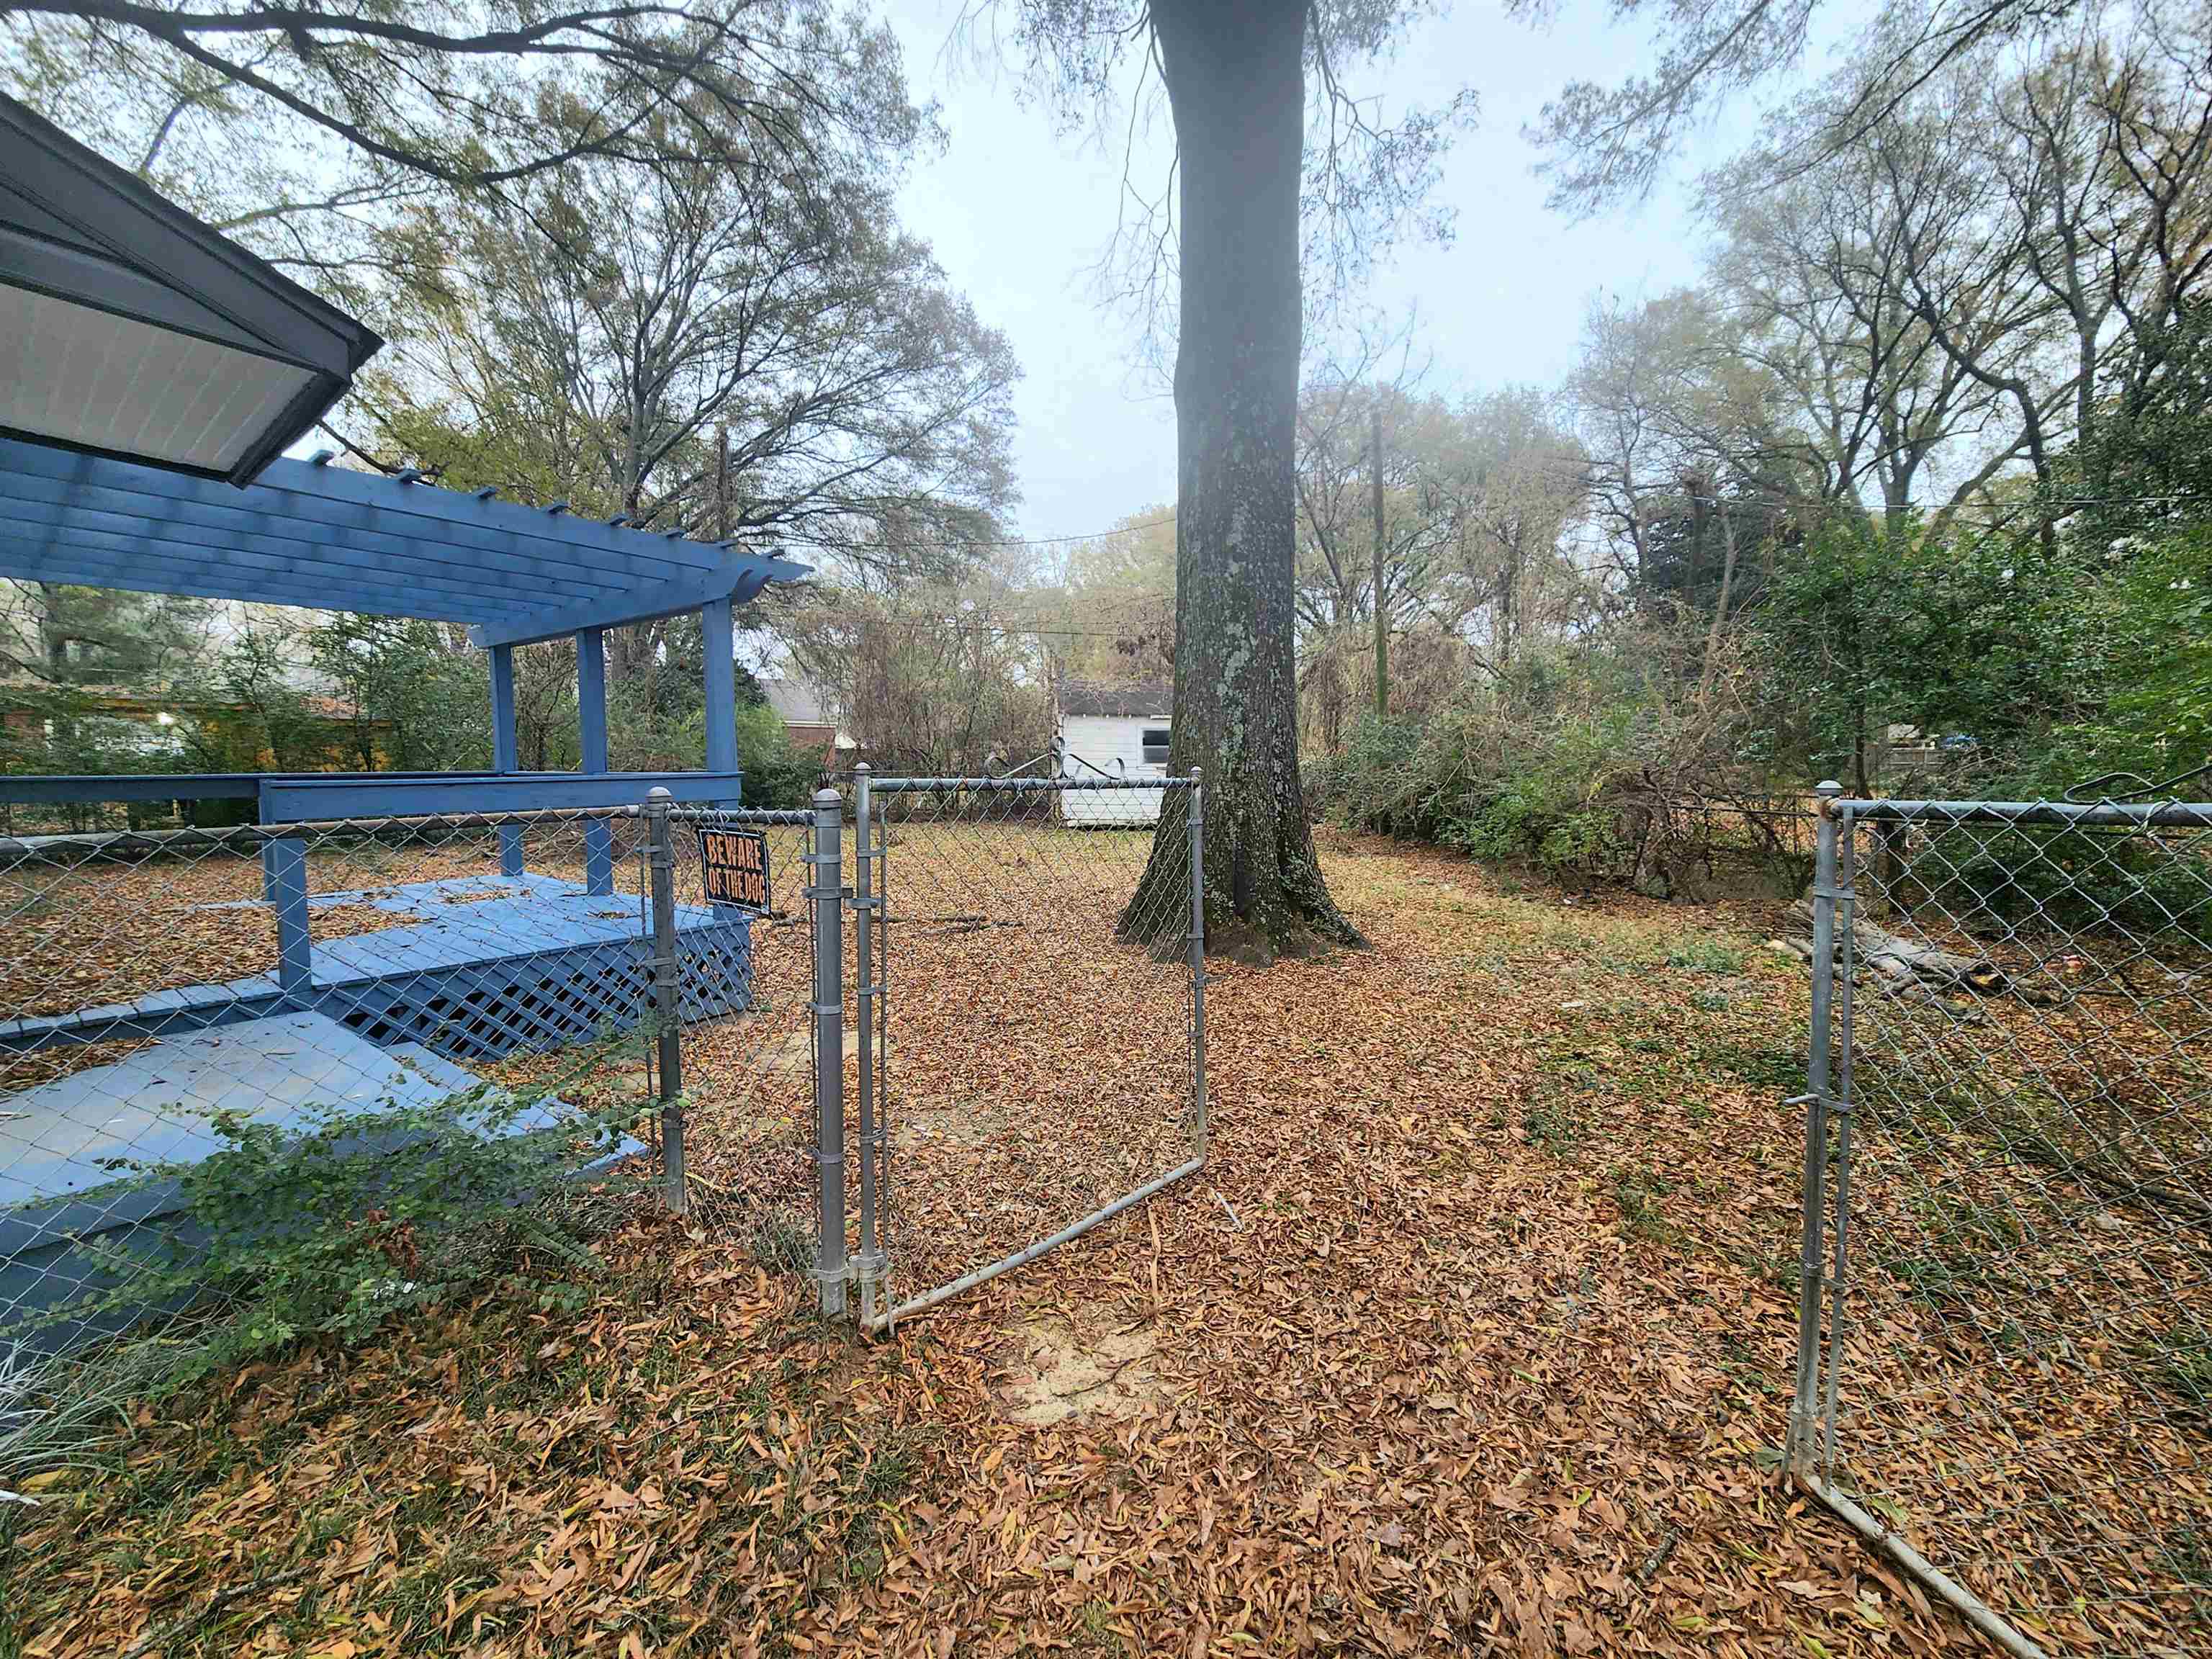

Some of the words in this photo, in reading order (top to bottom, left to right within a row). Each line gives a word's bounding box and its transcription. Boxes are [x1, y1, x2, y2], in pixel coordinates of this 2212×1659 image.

[706, 835, 763, 870] BEWARE
[709, 867, 724, 896] OF
[726, 868, 744, 899] THE
[745, 871, 765, 904] DOG
